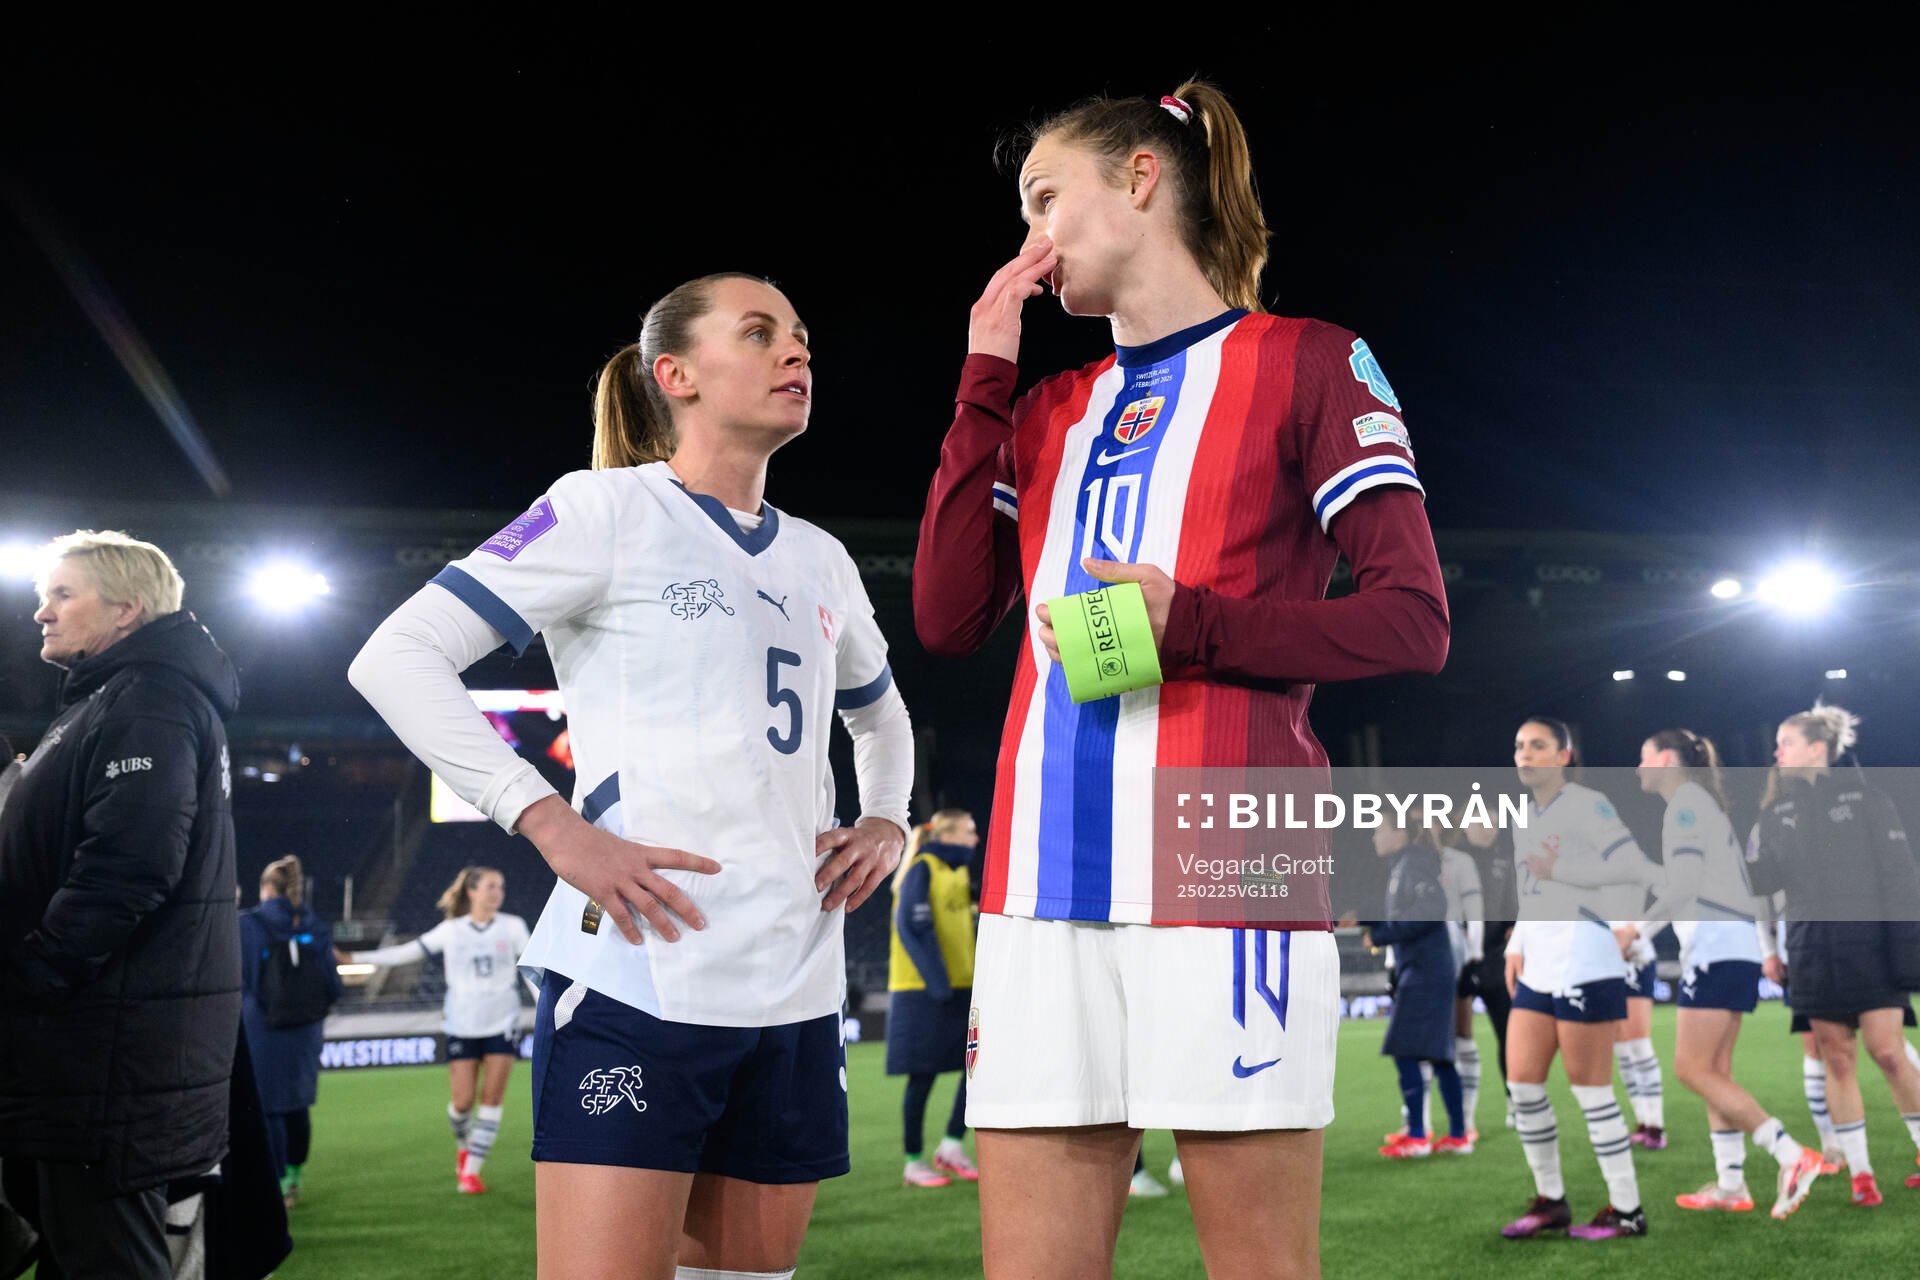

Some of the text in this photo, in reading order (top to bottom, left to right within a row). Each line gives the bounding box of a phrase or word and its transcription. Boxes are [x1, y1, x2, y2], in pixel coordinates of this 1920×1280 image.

[1135, 368, 1169, 380] SWITZERLAND
[1135, 377, 1160, 388] FEBRUARY
[1356, 416, 1373, 425] UEFA
[1080, 473, 1142, 574] 10
[1087, 588, 1116, 652] RESPEC
[767, 646, 803, 755] 5
[121, 757, 153, 773] UBS
[472, 955, 494, 978] 13
[320, 1036, 436, 1069] NVESTERER
